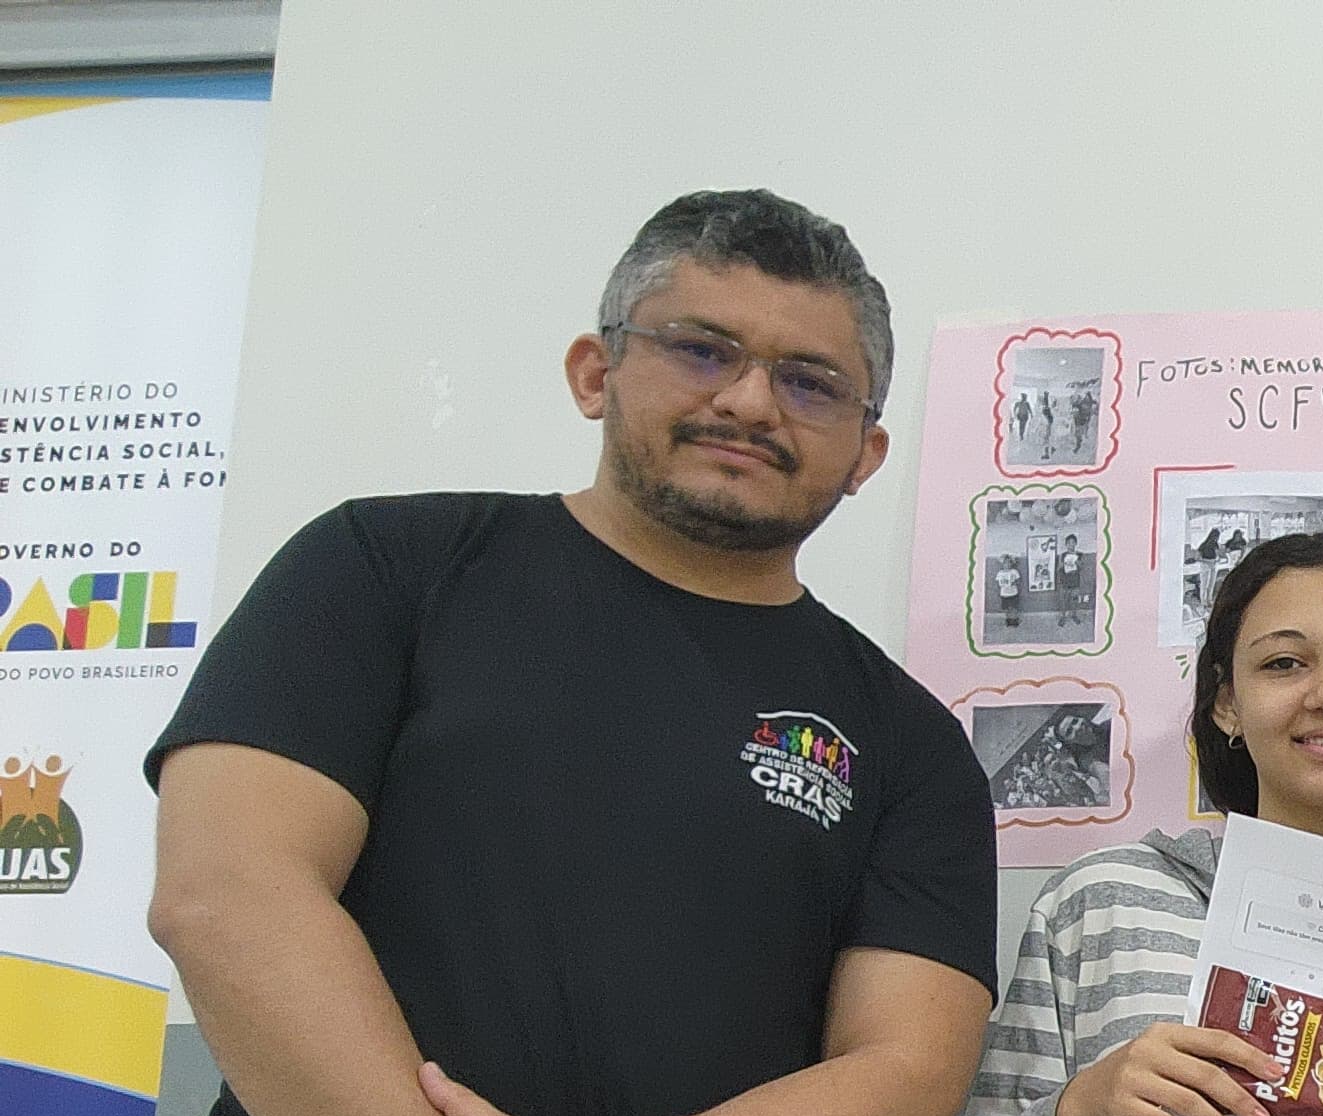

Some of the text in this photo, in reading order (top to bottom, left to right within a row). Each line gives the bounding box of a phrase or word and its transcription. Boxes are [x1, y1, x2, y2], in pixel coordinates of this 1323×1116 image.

[145, 382, 178, 399] DO
[122, 441, 225, 460] SOCIAL,
[23, 473, 146, 493] COMBATE
[157, 468, 170, 489] À
[110, 541, 142, 557] DO
[28, 667, 75, 680] POVO
[82, 664, 179, 679] BRASILEIRO
[750, 765, 841, 823] CRAS
